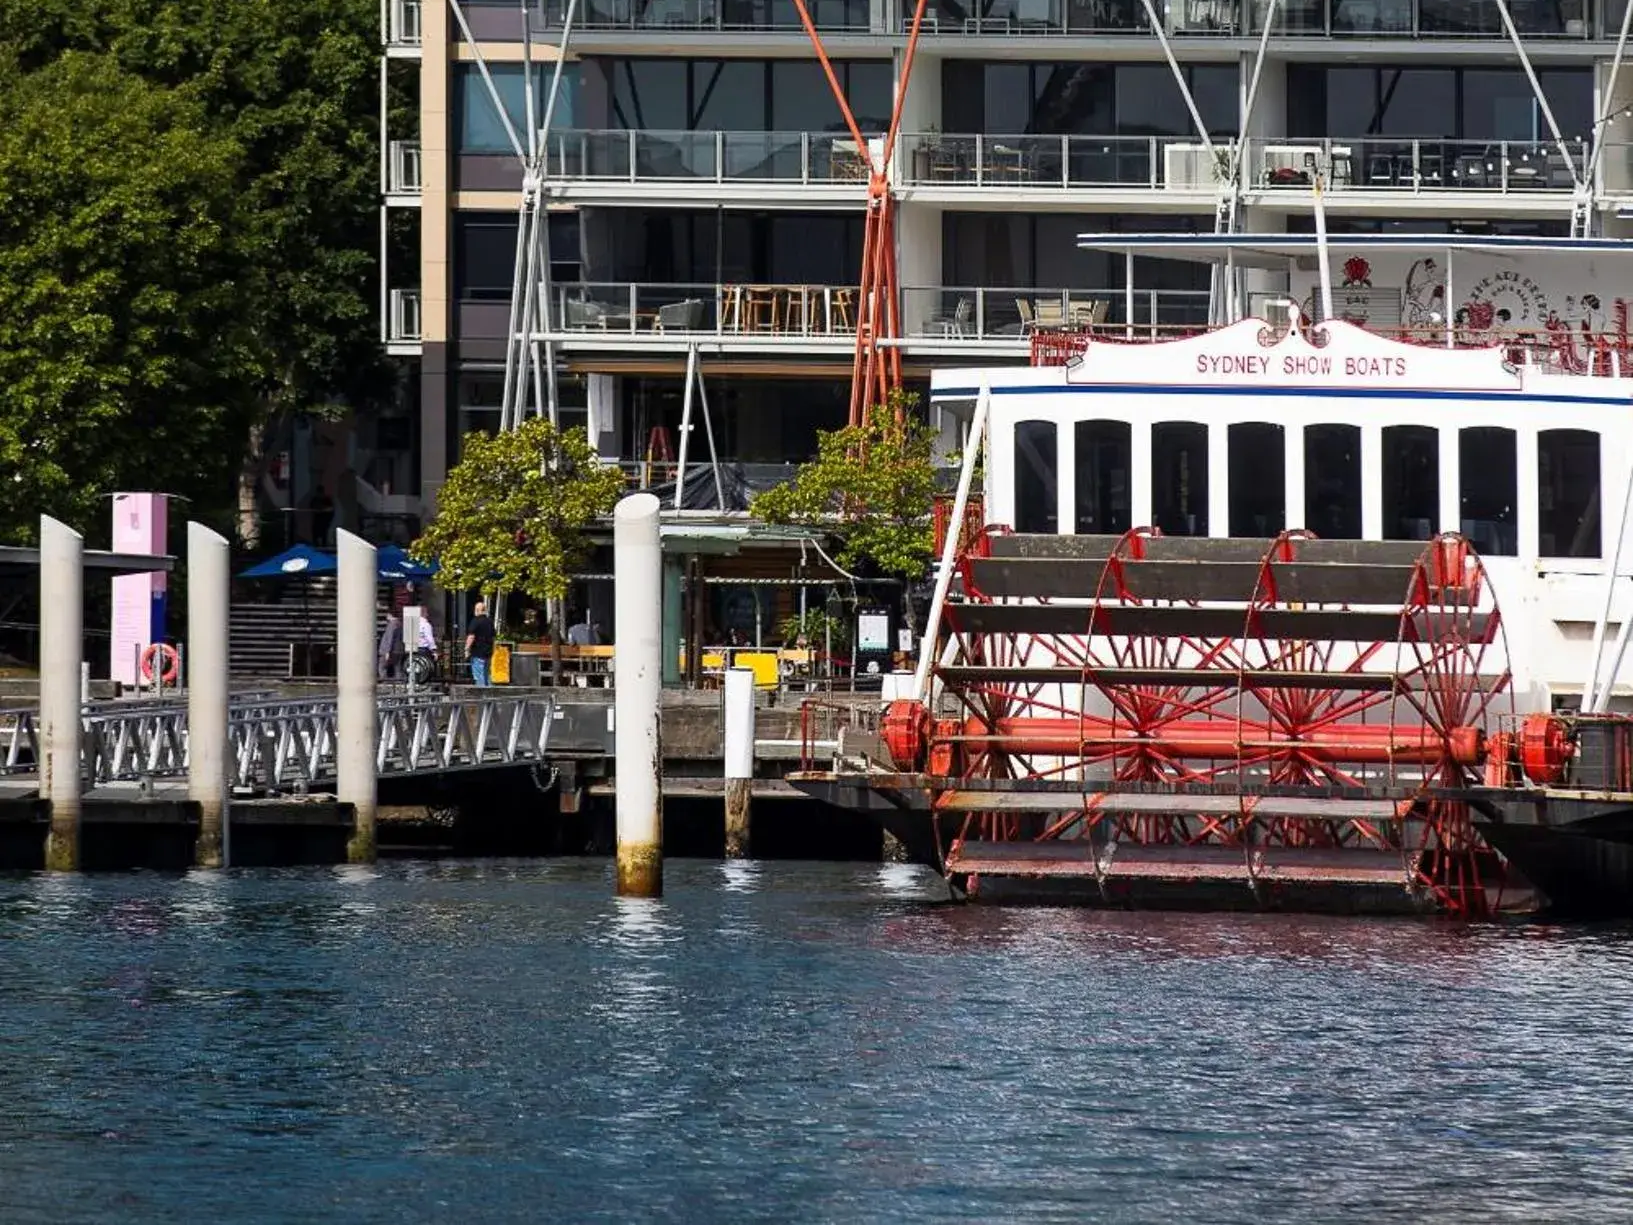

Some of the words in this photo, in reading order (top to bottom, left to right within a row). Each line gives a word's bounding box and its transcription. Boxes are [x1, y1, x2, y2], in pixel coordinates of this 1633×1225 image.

[1197, 354, 1270, 374] SYDNEY
[1283, 356, 1332, 375] SHOW
[1345, 357, 1407, 376] BOATS
